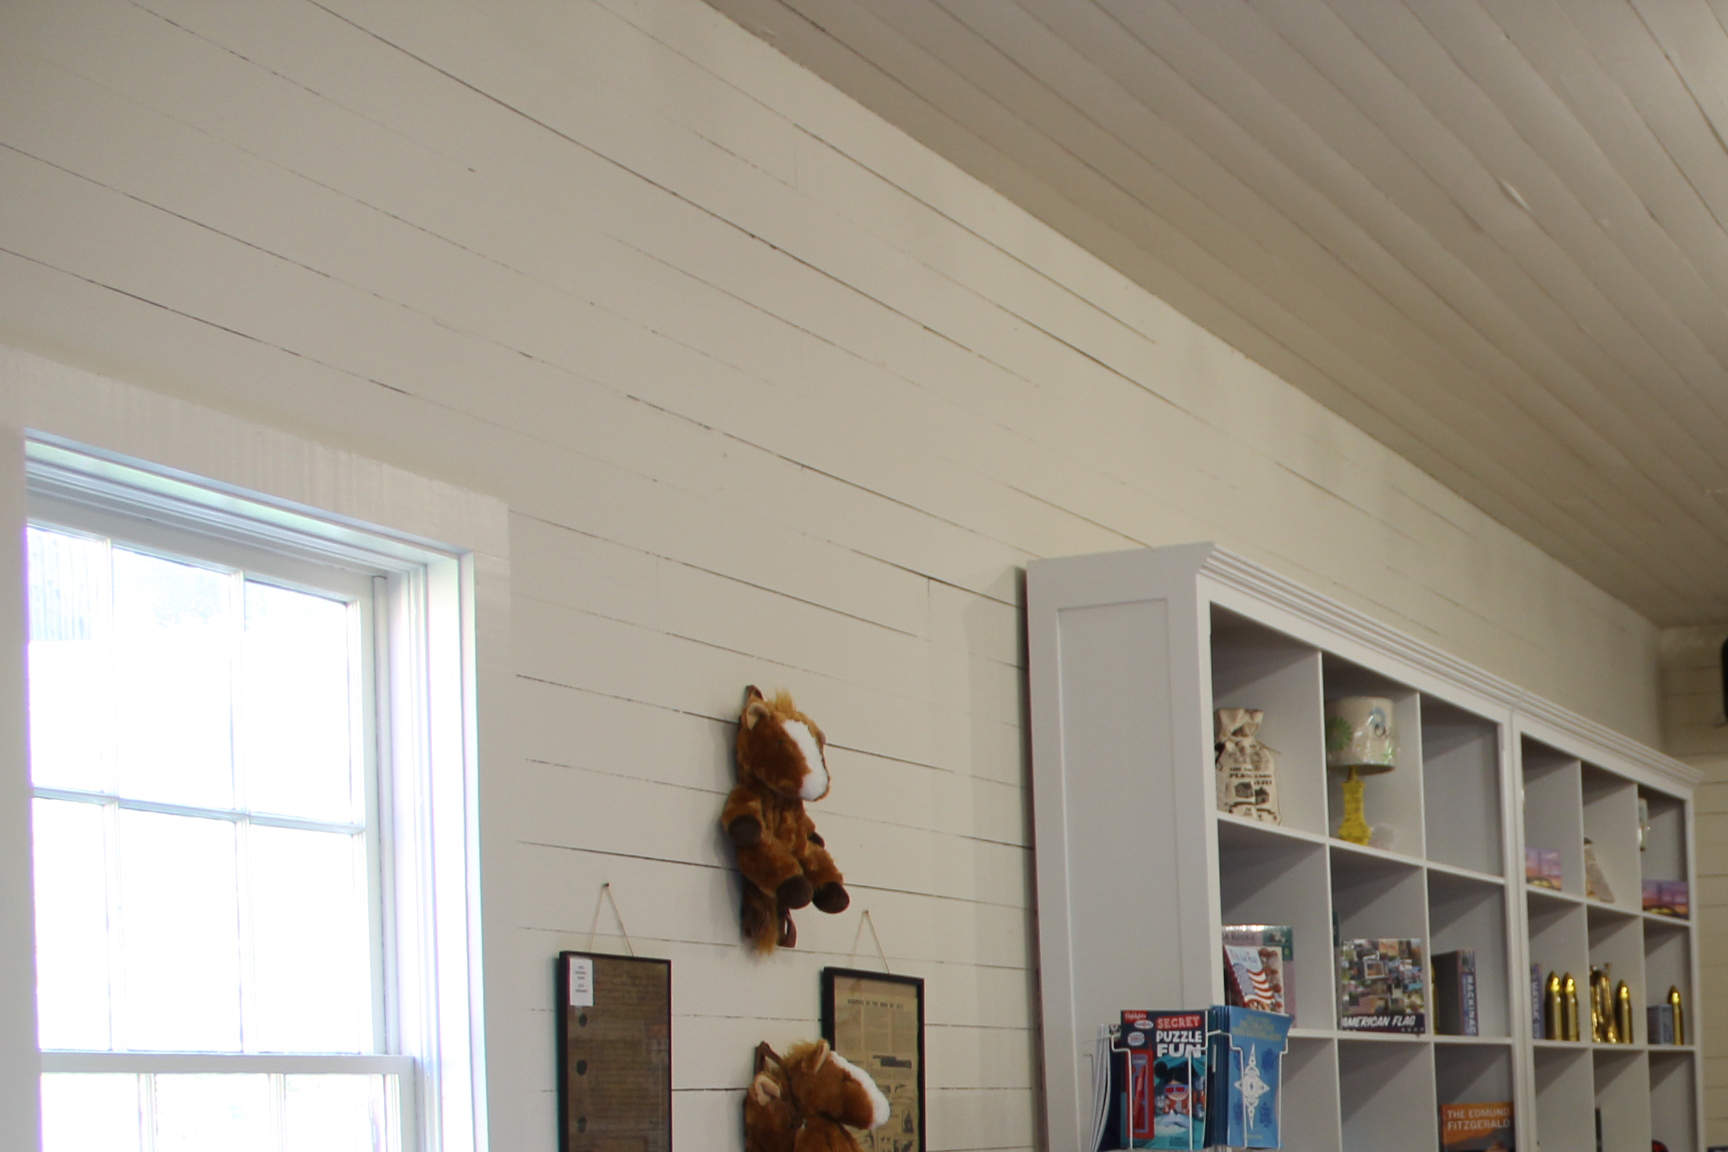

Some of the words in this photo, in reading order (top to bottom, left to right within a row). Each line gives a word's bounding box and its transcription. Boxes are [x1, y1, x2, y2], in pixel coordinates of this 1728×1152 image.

[1157, 1015, 1200, 1030] SECRET
[1341, 1015, 1390, 1029] AMERICAN
[1391, 1014, 1417, 1027] FLAG
[1156, 1030, 1203, 1043] PUZZLE
[1156, 1043, 1202, 1059] FUN
[1447, 1109, 1466, 1119] THE
[1469, 1107, 1510, 1118] EDMUND
[1447, 1118, 1511, 1131] FITZGERALD
